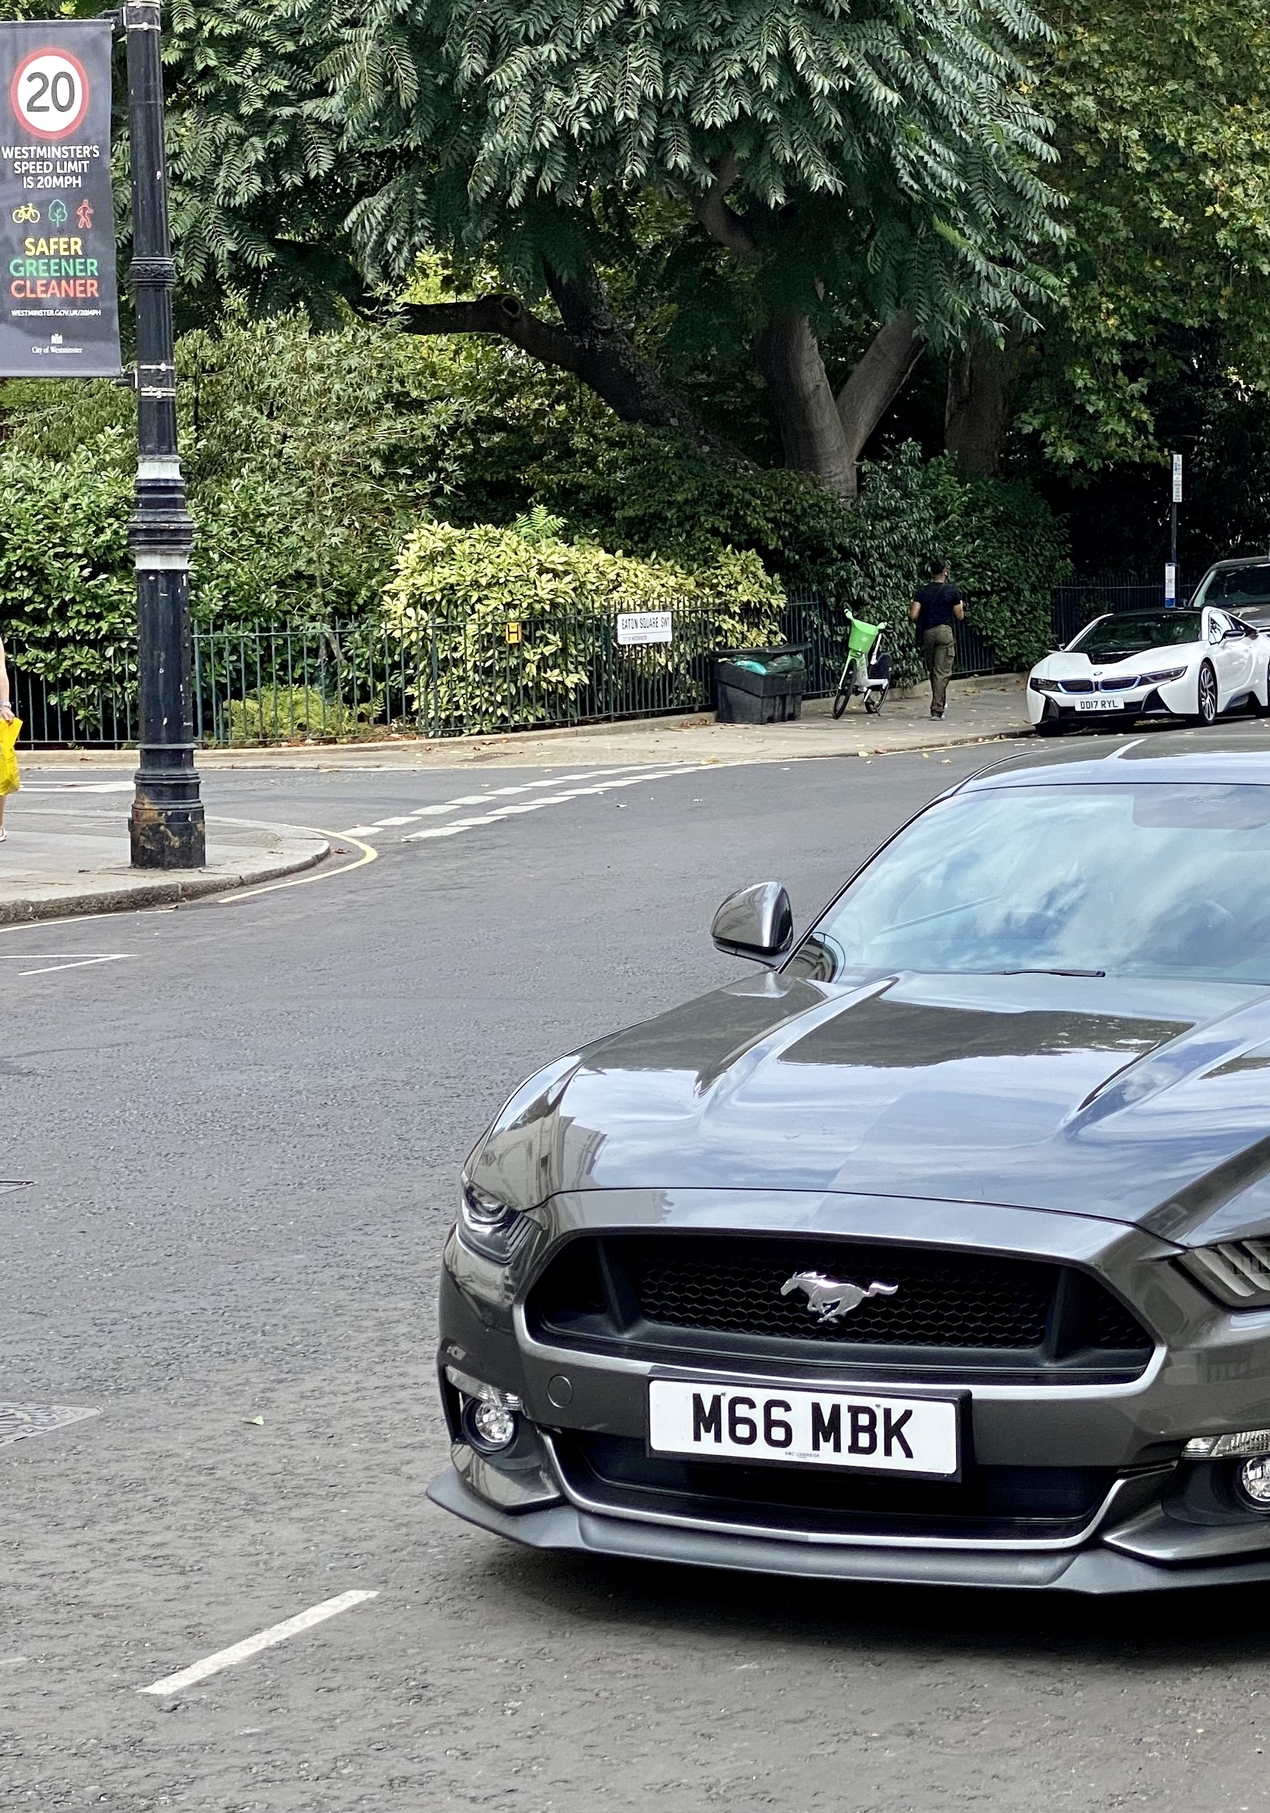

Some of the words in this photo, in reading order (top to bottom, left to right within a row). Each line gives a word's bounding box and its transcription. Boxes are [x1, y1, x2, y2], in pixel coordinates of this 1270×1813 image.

[26, 71, 75, 113] 20
[1, 145, 100, 159] WESTMINSTER'S
[14, 161, 53, 174] SPEED
[56, 160, 90, 173] LIMIT
[23, 176, 34, 189] IS
[37, 176, 82, 189] 20MPH
[25, 237, 83, 256] SAFER
[9, 258, 99, 277] GREENER
[10, 279, 99, 298] CLEANER
[31, 346, 42, 355] City
[622, 618, 638, 629] EATON
[640, 617, 659, 629] SQUARE
[1100, 699, 1118, 709] RYL
[693, 1393, 793, 1449] M66
[811, 1402, 914, 1459] MBK
